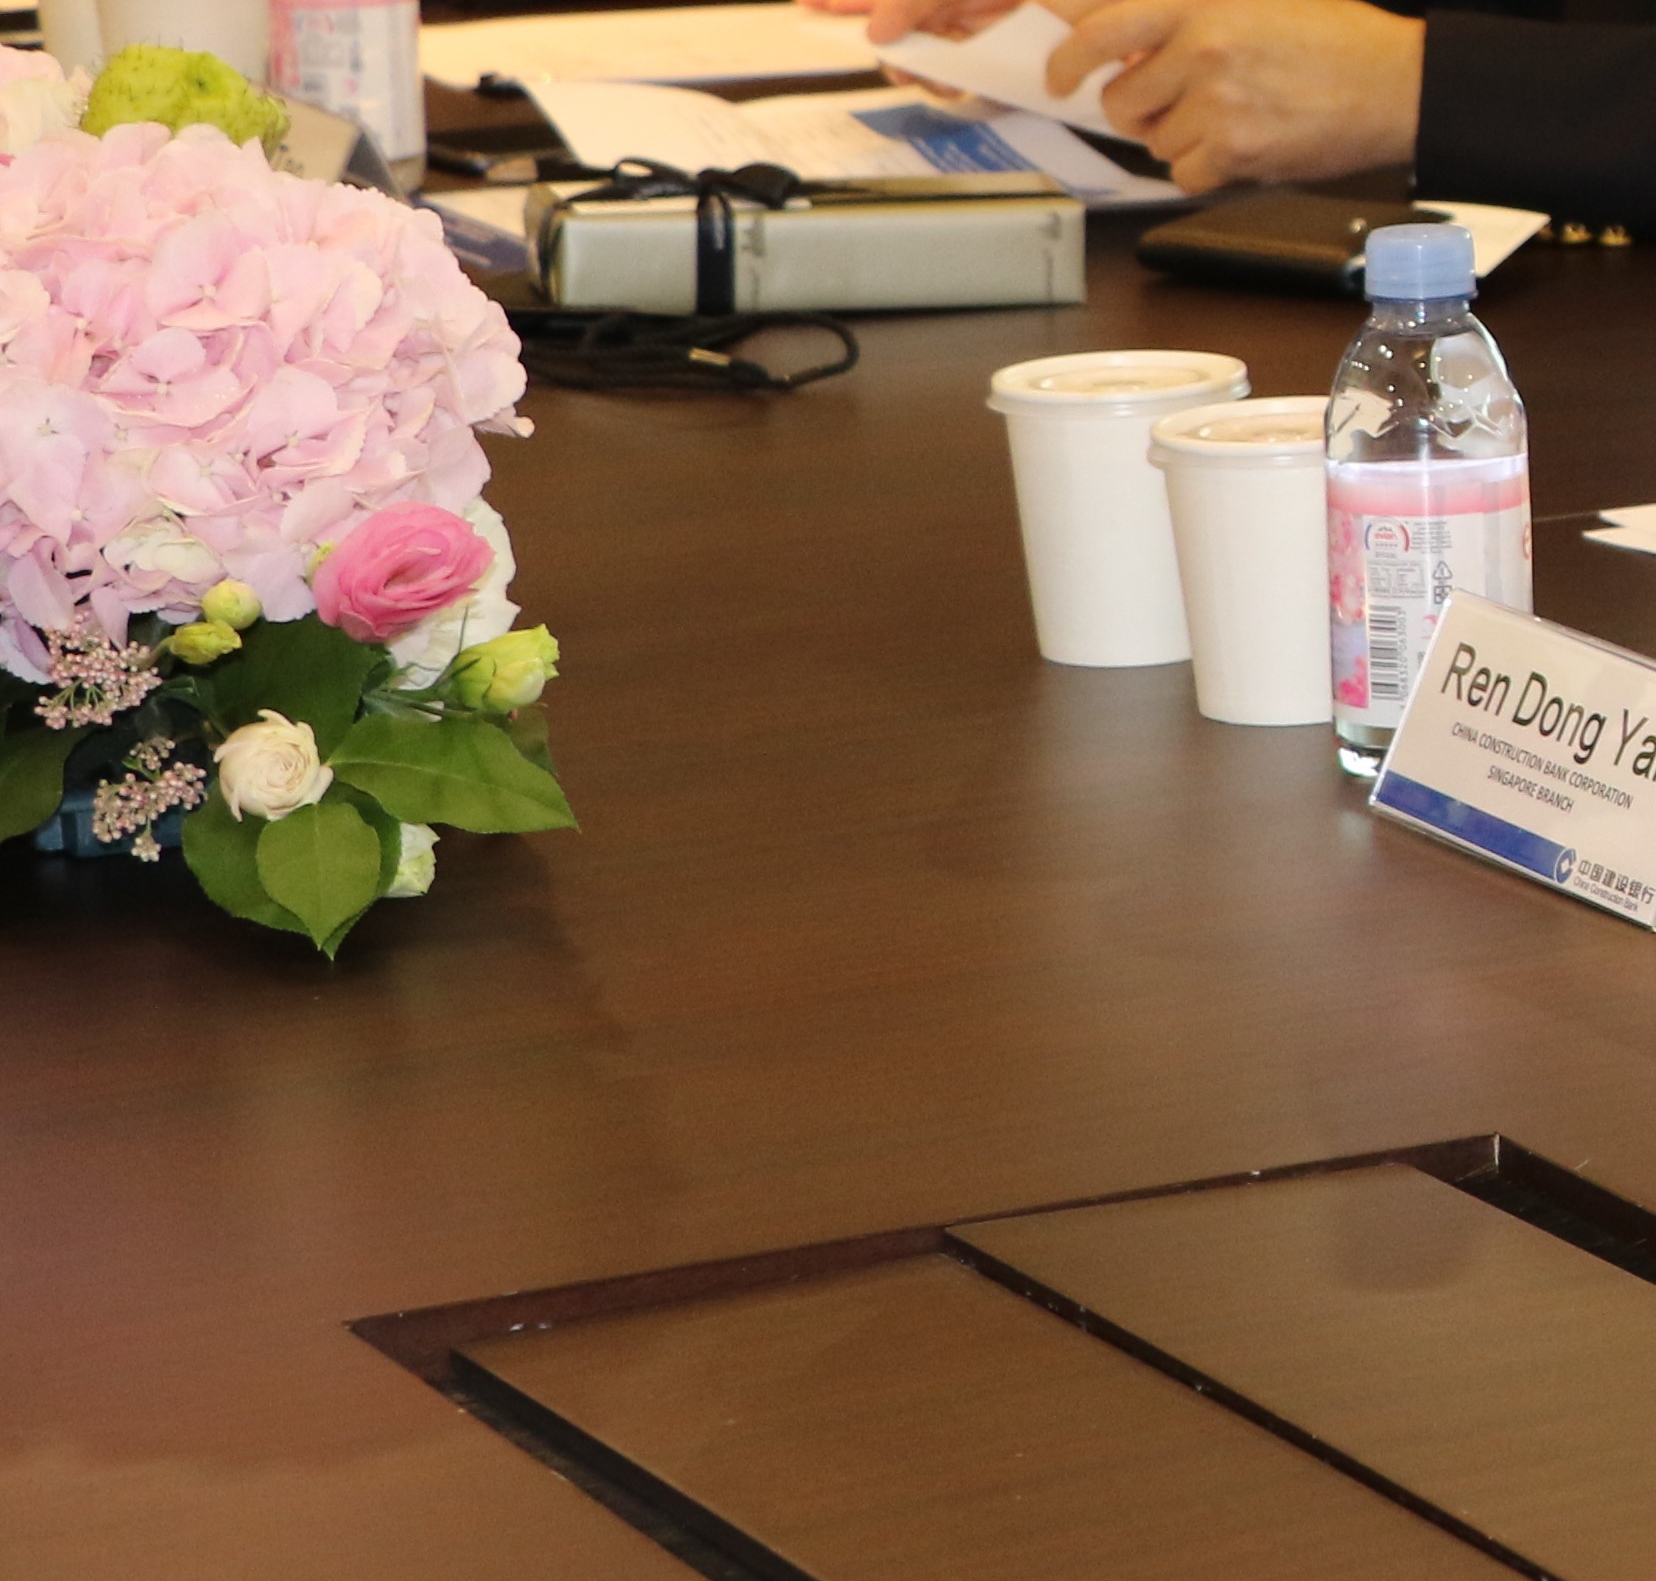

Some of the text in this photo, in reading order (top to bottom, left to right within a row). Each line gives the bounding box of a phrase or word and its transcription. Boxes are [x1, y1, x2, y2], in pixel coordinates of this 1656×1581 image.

[1441, 642, 1512, 716] Ren
[1512, 671, 1607, 765] Dong
[1452, 722, 1634, 809] CHINA CONSTRUCTION BANK CORPORATION
[1487, 765, 1576, 813] SINGAPORE BRANCH
[1578, 860, 1656, 904] 中国建设银行
[1589, 882, 1624, 904] Construction
